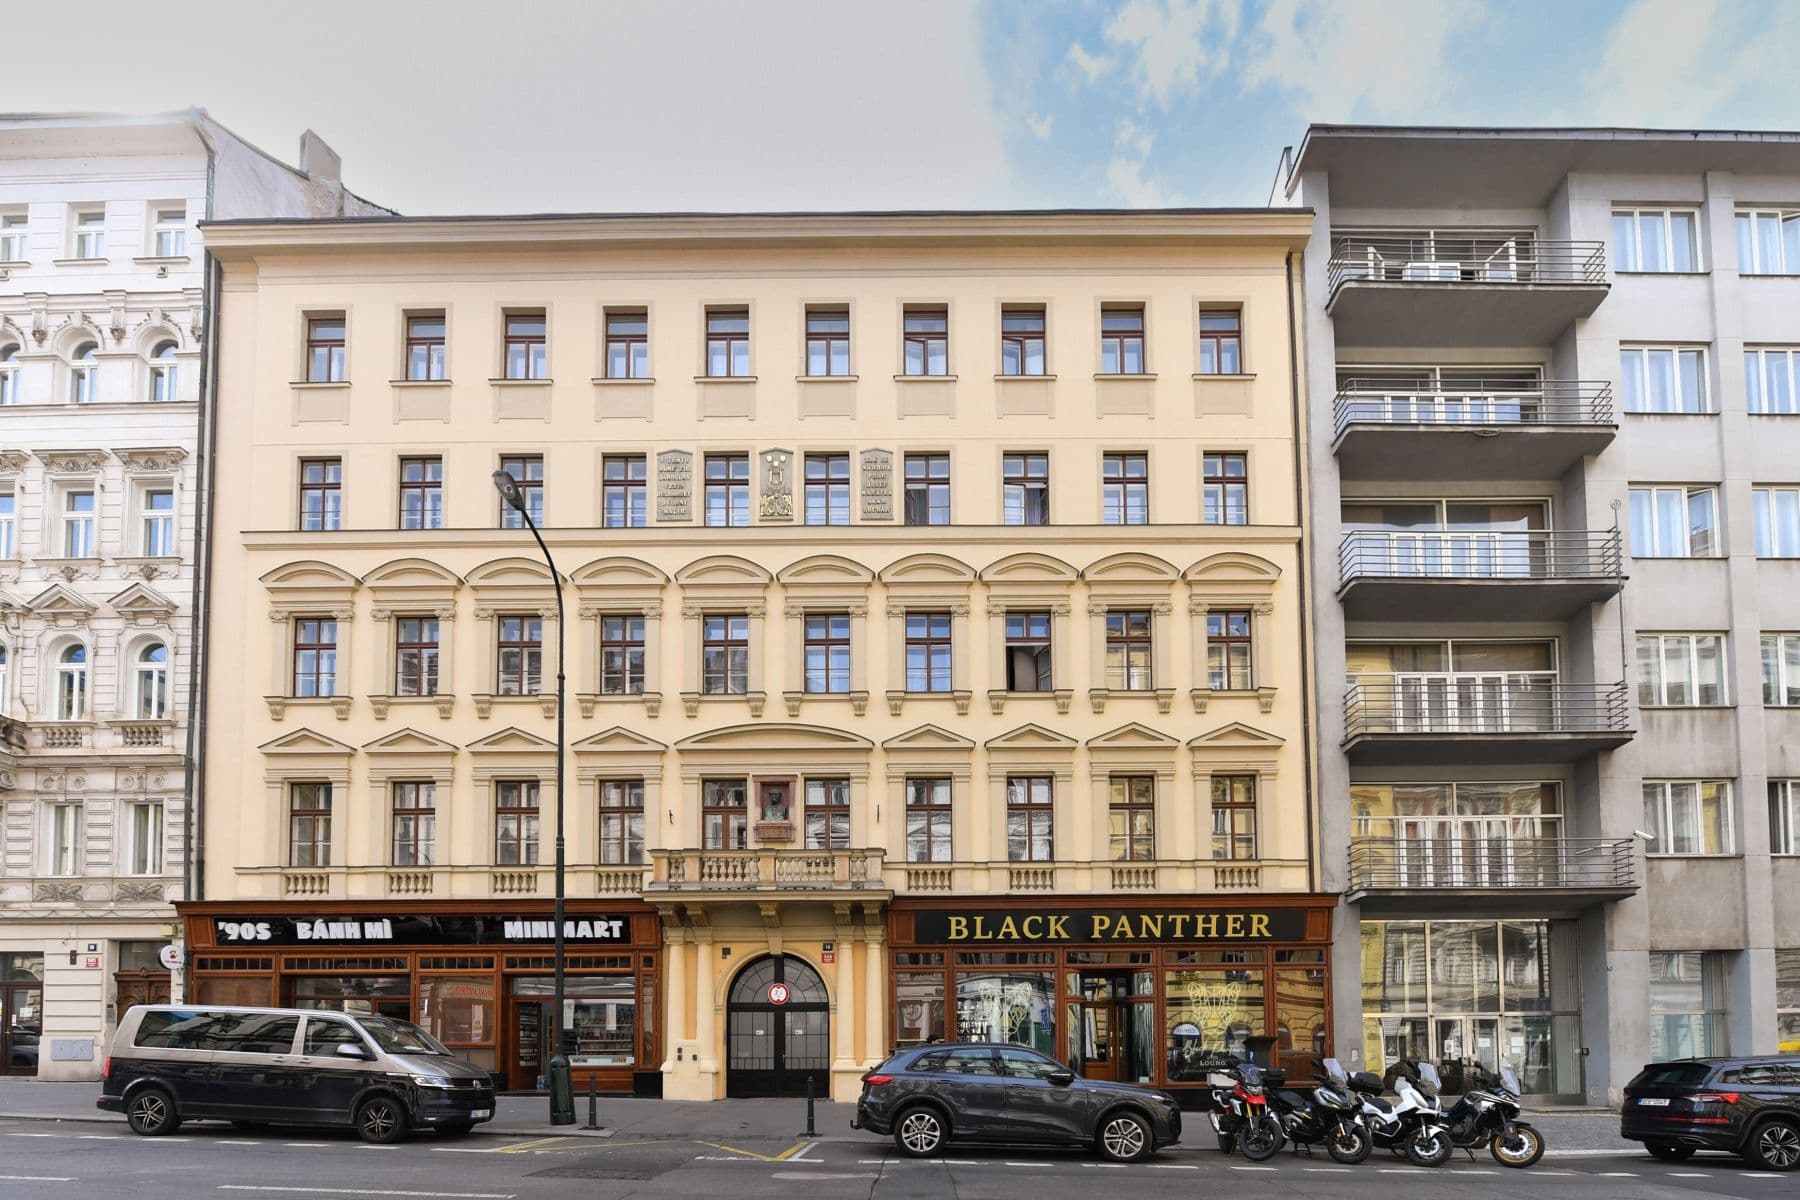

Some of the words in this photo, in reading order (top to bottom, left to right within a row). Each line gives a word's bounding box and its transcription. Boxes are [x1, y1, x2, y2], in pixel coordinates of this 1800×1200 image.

[296, 919, 361, 940] BÁNH
[364, 919, 393, 939] MÌ
[504, 920, 623, 939] MINIMART
[948, 915, 1070, 940] BLACK
[1091, 914, 1272, 938] PANTHER
